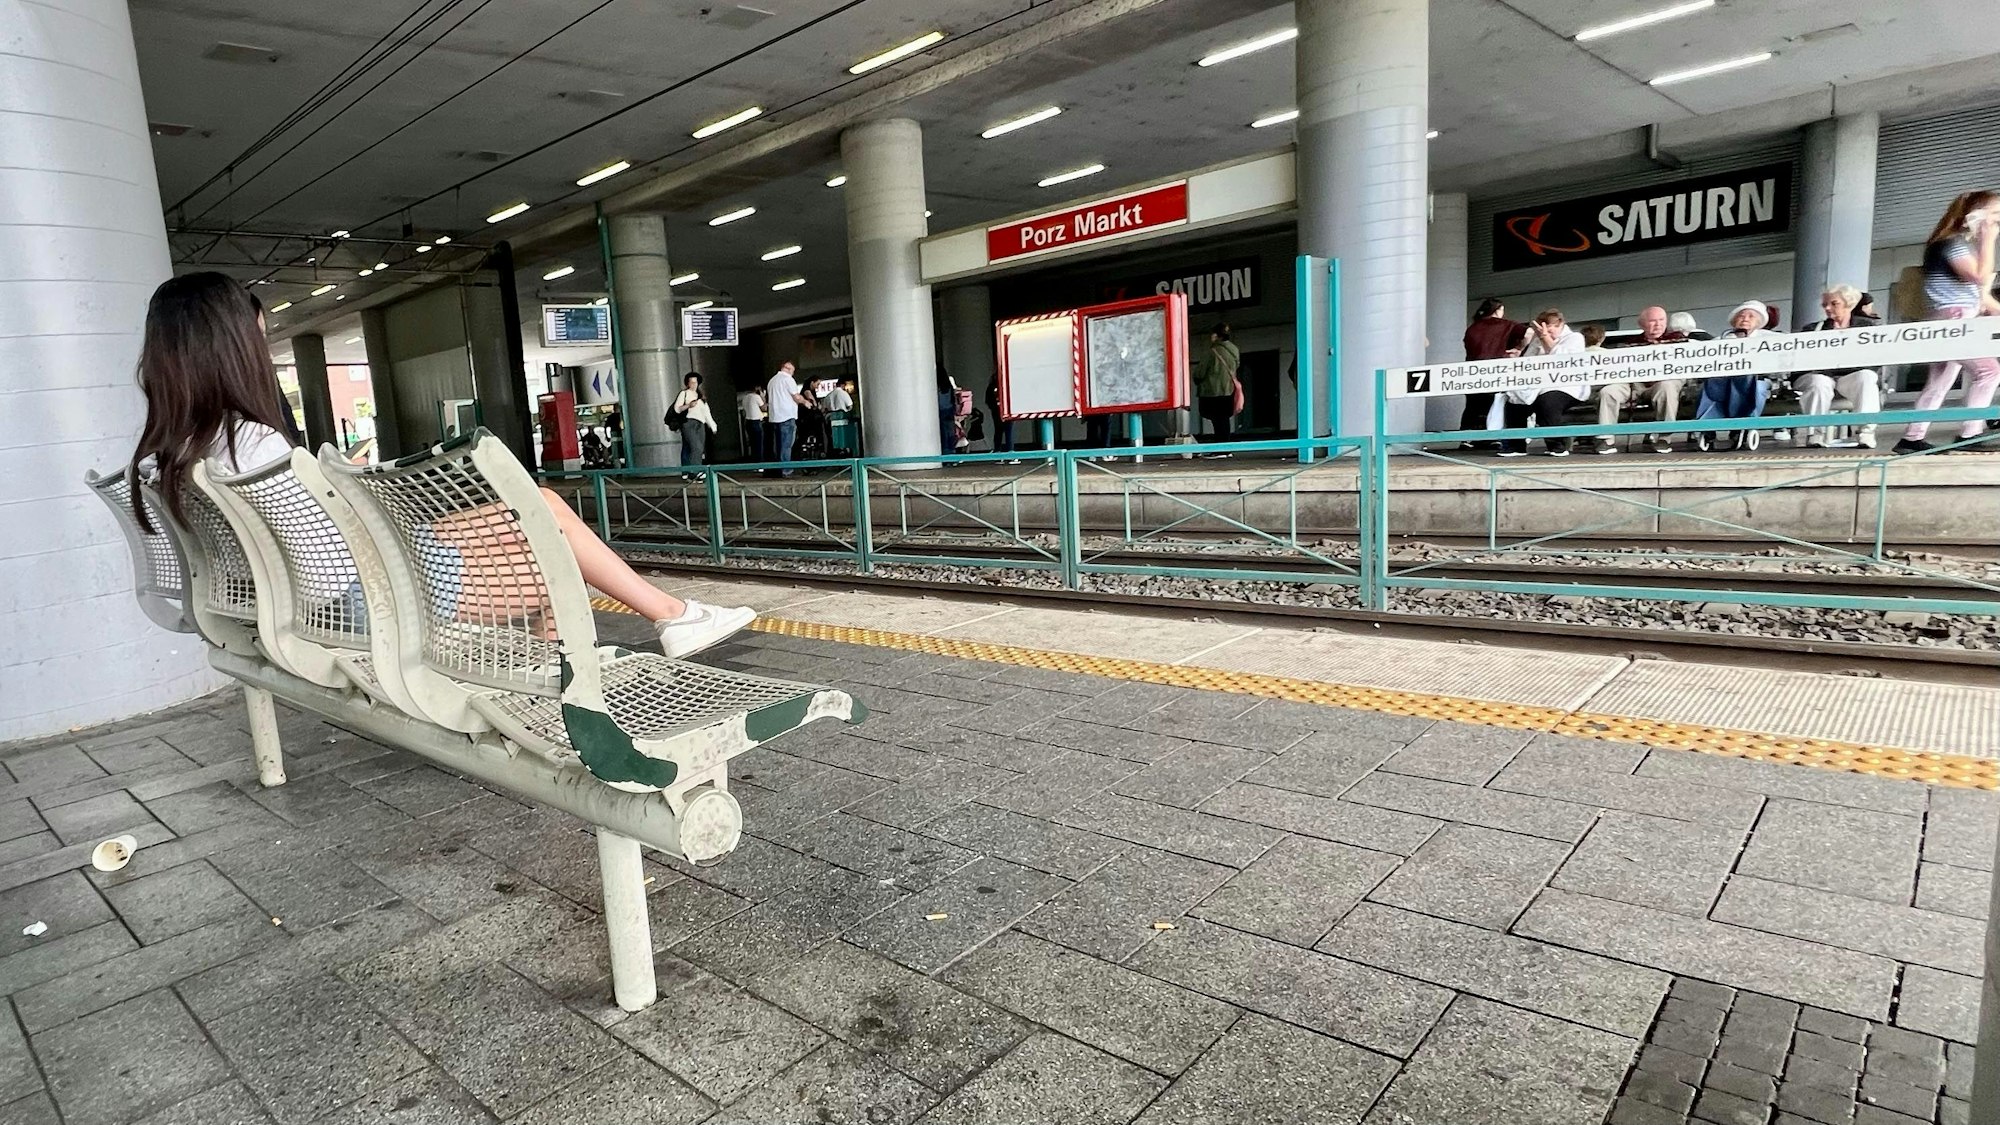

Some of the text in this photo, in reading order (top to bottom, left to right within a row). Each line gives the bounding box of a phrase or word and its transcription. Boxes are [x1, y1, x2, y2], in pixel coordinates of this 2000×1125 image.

[1021, 203, 1143, 249] Porz Markt
[1597, 178, 1775, 245] SATURN
[1857, 324, 1974, 345] Str./Gürtel-
[1410, 372, 1427, 390] 7
[1441, 358, 1752, 391] Marsdorf-Haus Vorst-Frechen-Benzelrath
